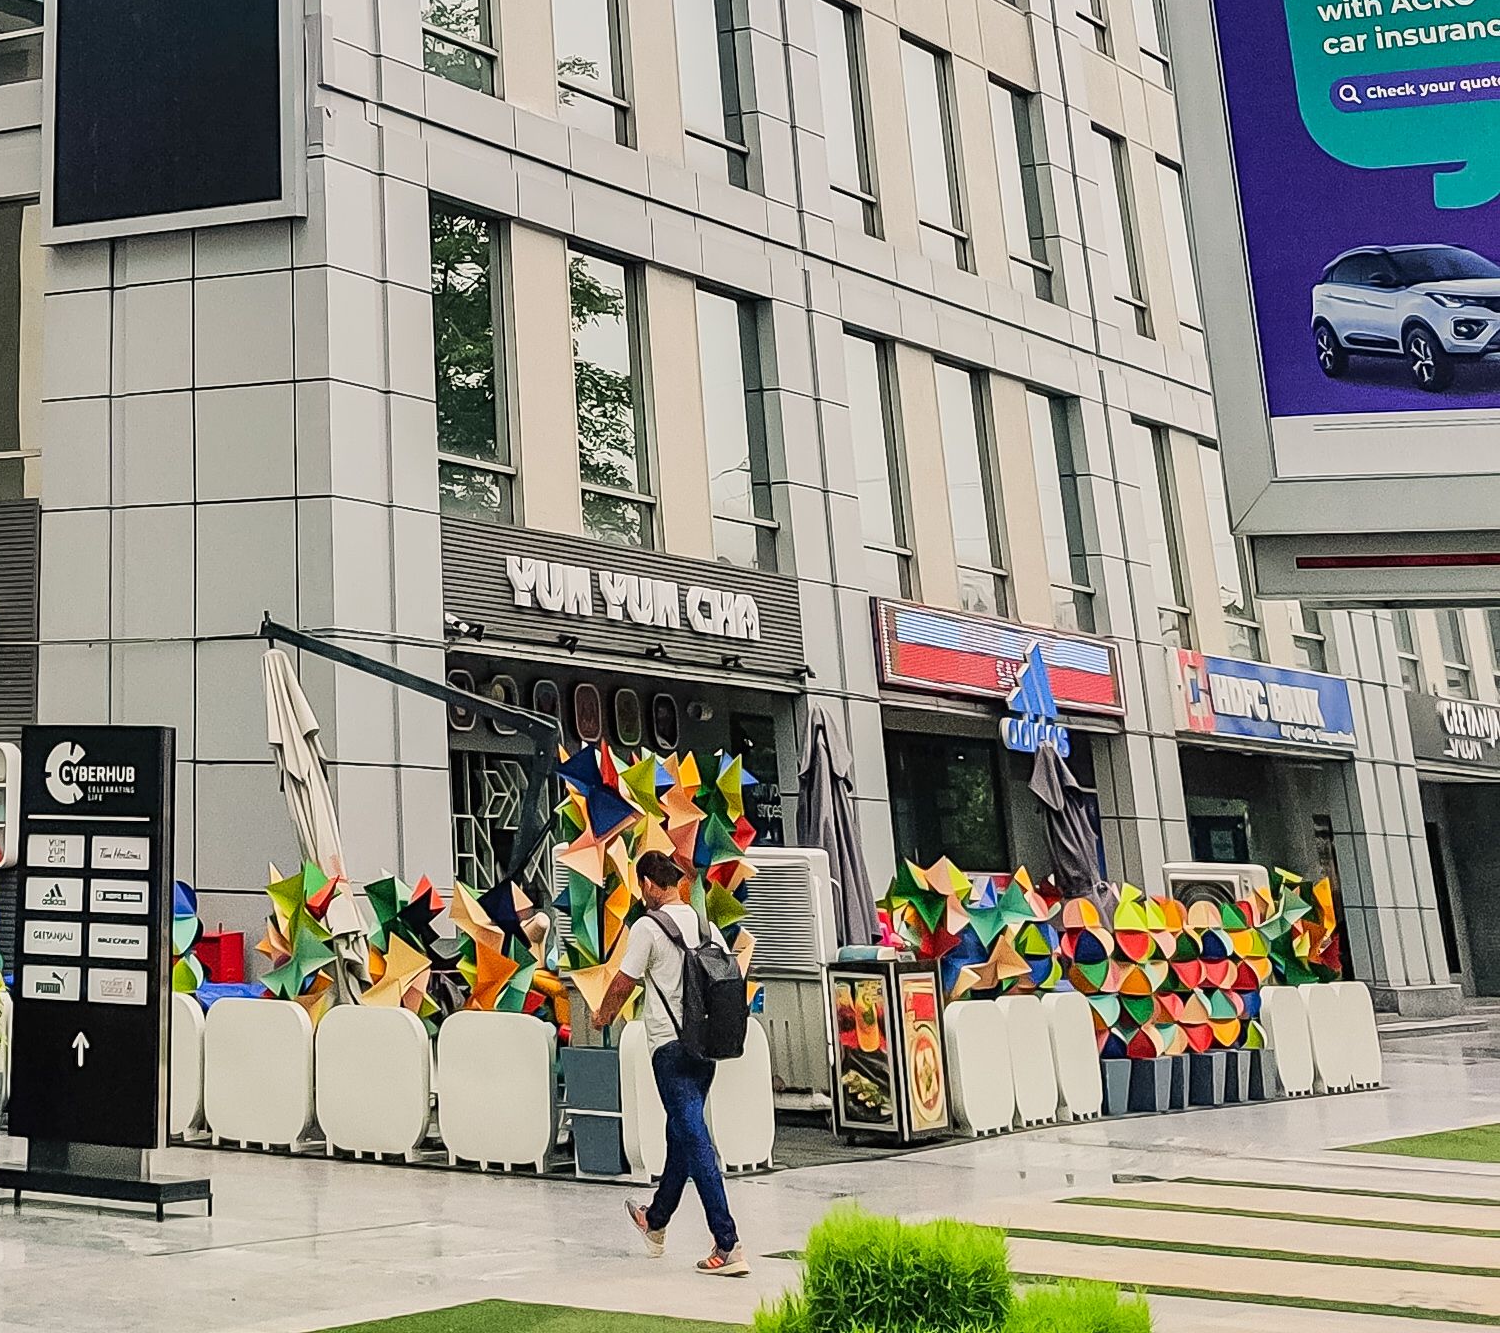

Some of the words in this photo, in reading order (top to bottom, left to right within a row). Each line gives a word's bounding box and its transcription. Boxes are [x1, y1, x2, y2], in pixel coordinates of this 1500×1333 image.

[1322, 32, 1368, 55] car
[1366, 81, 1417, 100] Check
[1419, 81, 1456, 97] your
[504, 555, 594, 617] YUM
[597, 569, 682, 630] YUM
[685, 585, 761, 641] CHA
[1208, 673, 1270, 723] HDFC
[1265, 682, 1326, 729] BANK
[61, 765, 136, 783] CYBERHUB
[41, 897, 67, 907] adidas
